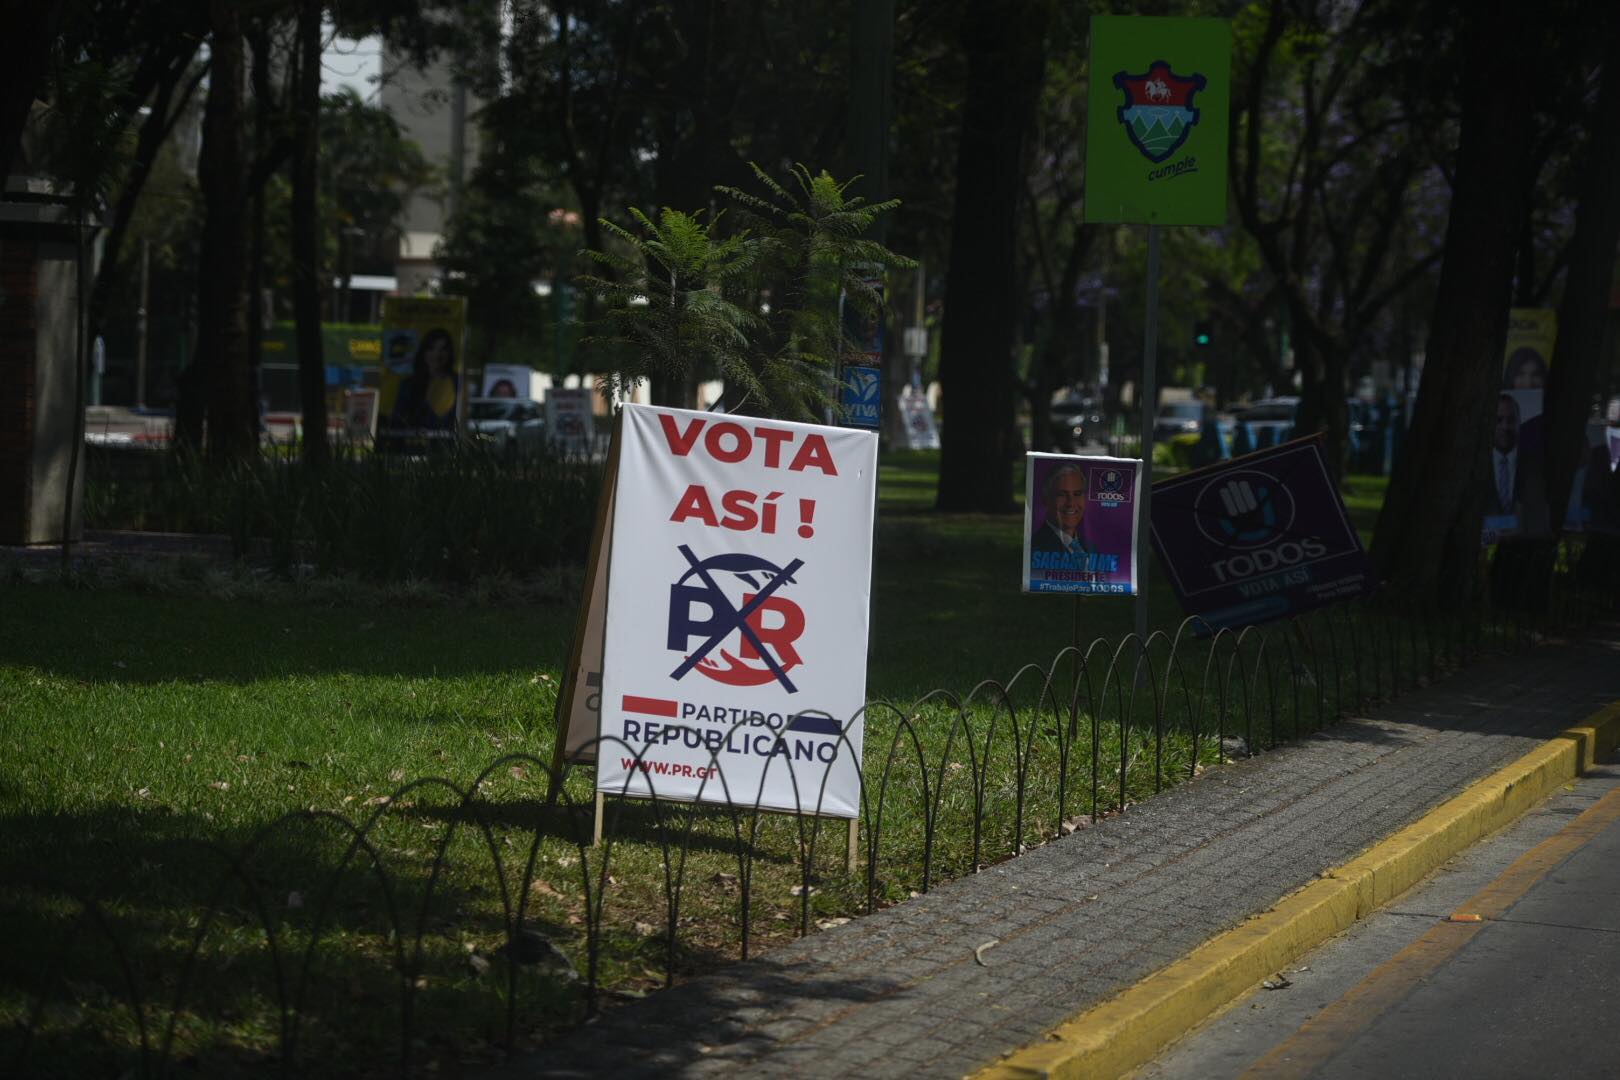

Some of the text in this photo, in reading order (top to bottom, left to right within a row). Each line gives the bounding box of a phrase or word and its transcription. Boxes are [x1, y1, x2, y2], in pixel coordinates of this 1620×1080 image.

[1148, 156, 1197, 182] cumple
[658, 414, 838, 476] VOTA
[1211, 536, 1328, 583] TODOS
[1045, 569, 1105, 582] PRESIDENTE
[1238, 577, 1280, 598] VOTA
[682, 702, 783, 731] PARTIDO
[623, 719, 838, 764] REPUBLICANO
[621, 757, 718, 780] WWW.PR.GT
